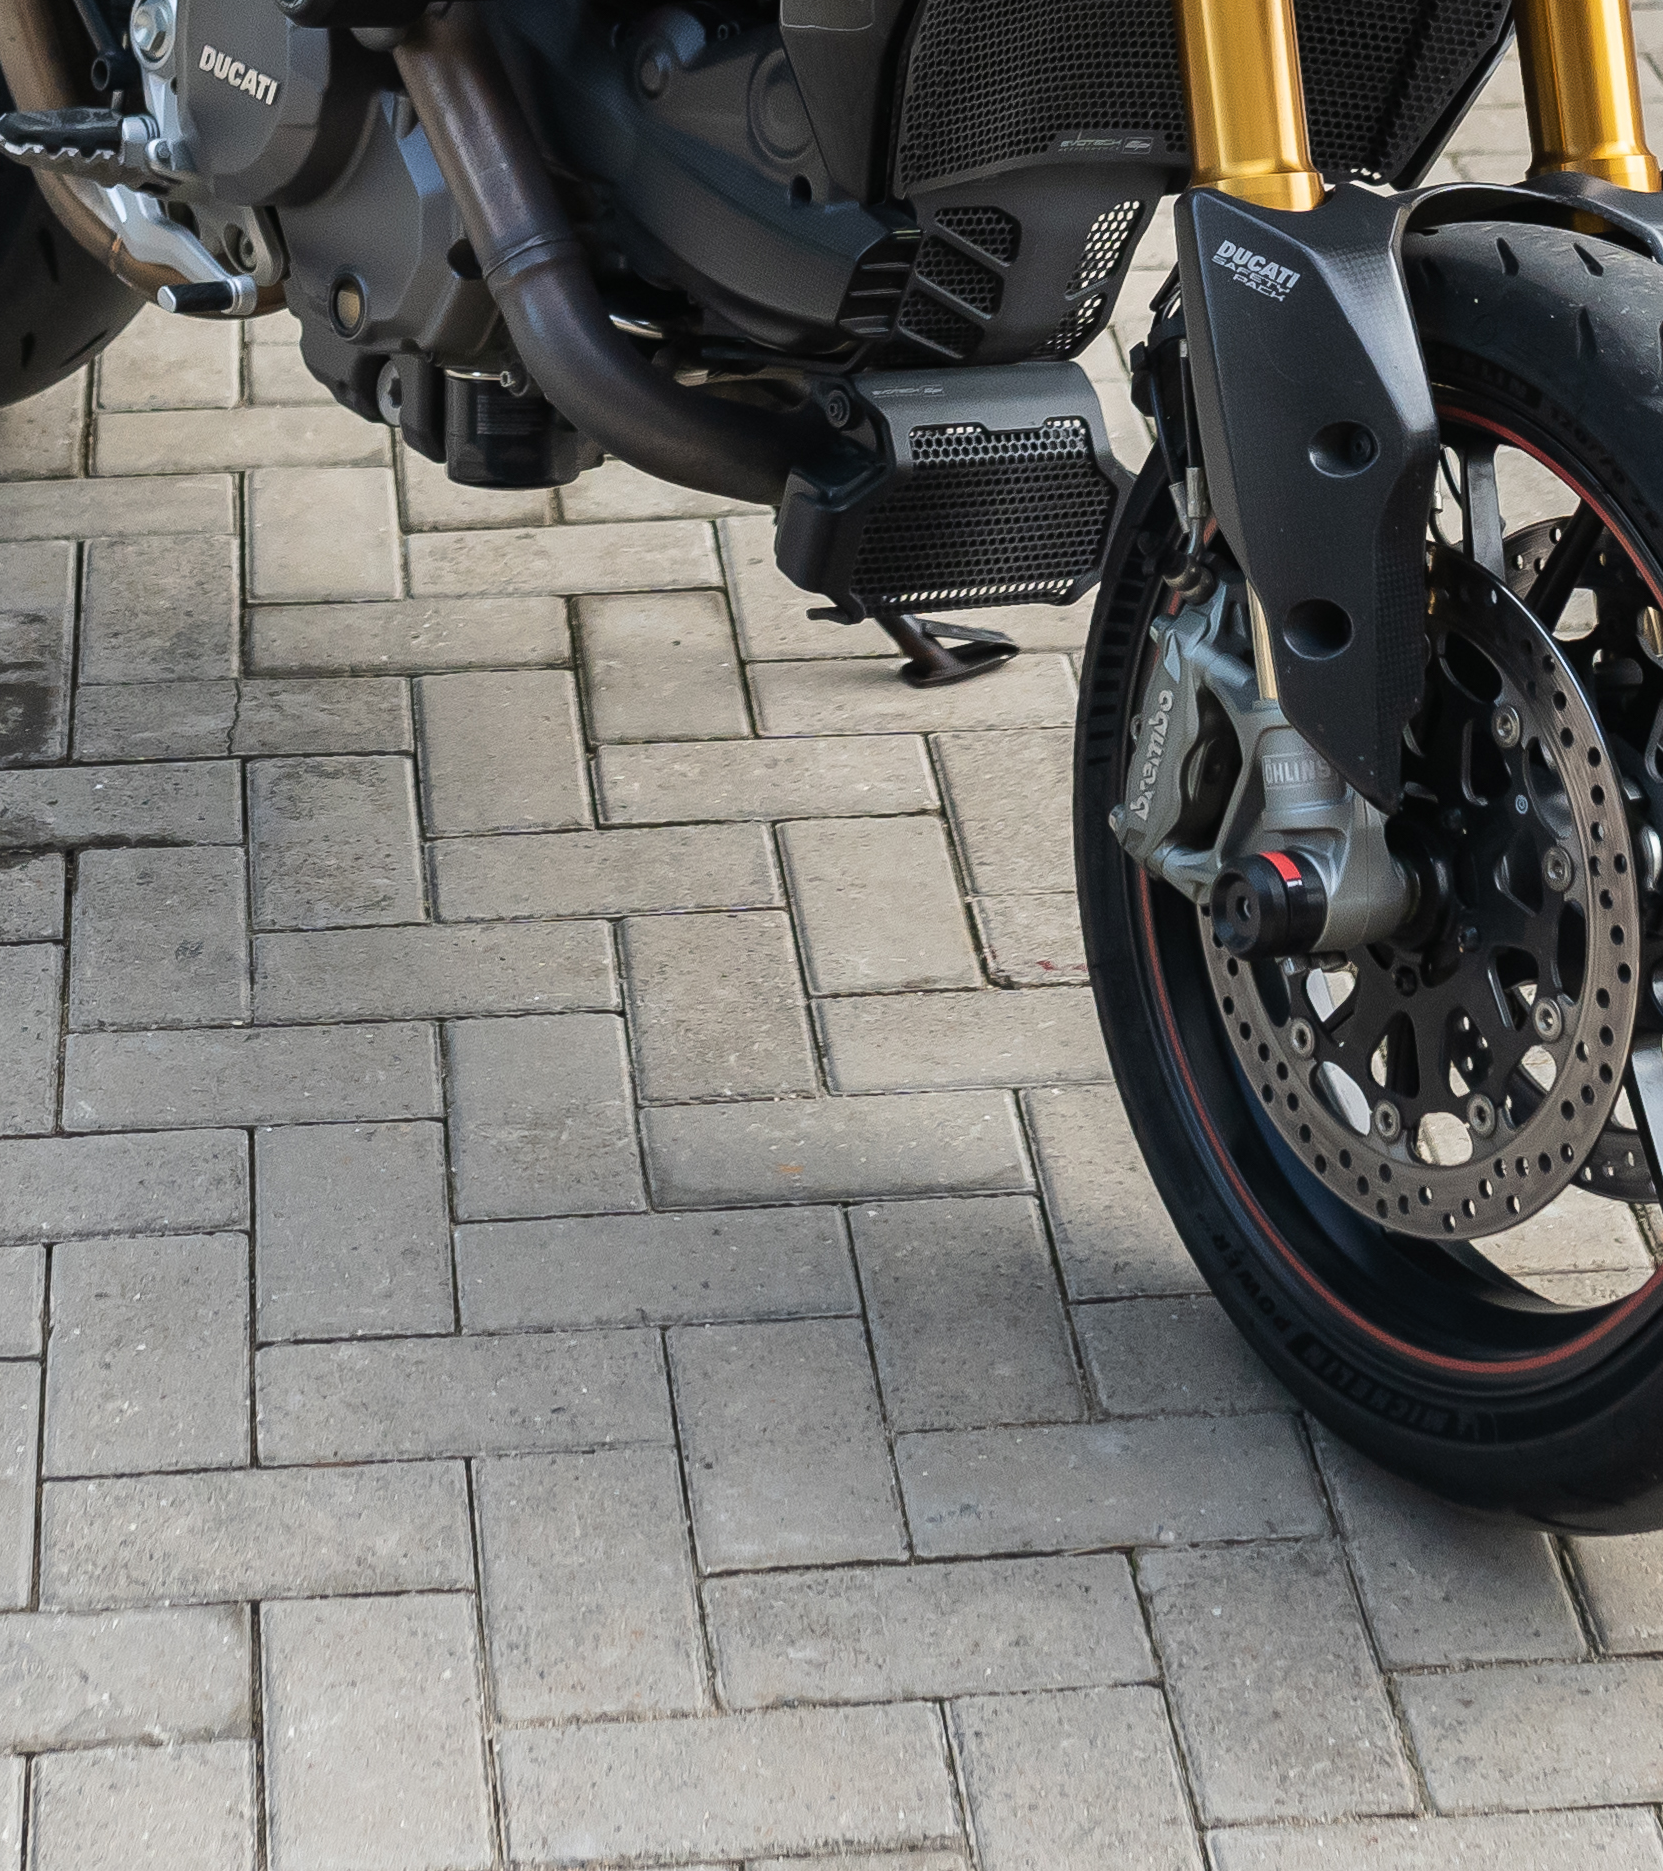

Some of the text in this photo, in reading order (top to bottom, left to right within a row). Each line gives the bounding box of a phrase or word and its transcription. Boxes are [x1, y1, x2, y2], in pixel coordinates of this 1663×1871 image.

[198, 44, 279, 105] DUCATI
[1211, 255, 1291, 295] SAFETY
[1216, 239, 1301, 288] DUCATI
[1232, 273, 1286, 302] PACK
[1130, 689, 1174, 821] brembo
[1211, 1234, 1451, 1430] MICHELIN POWER
